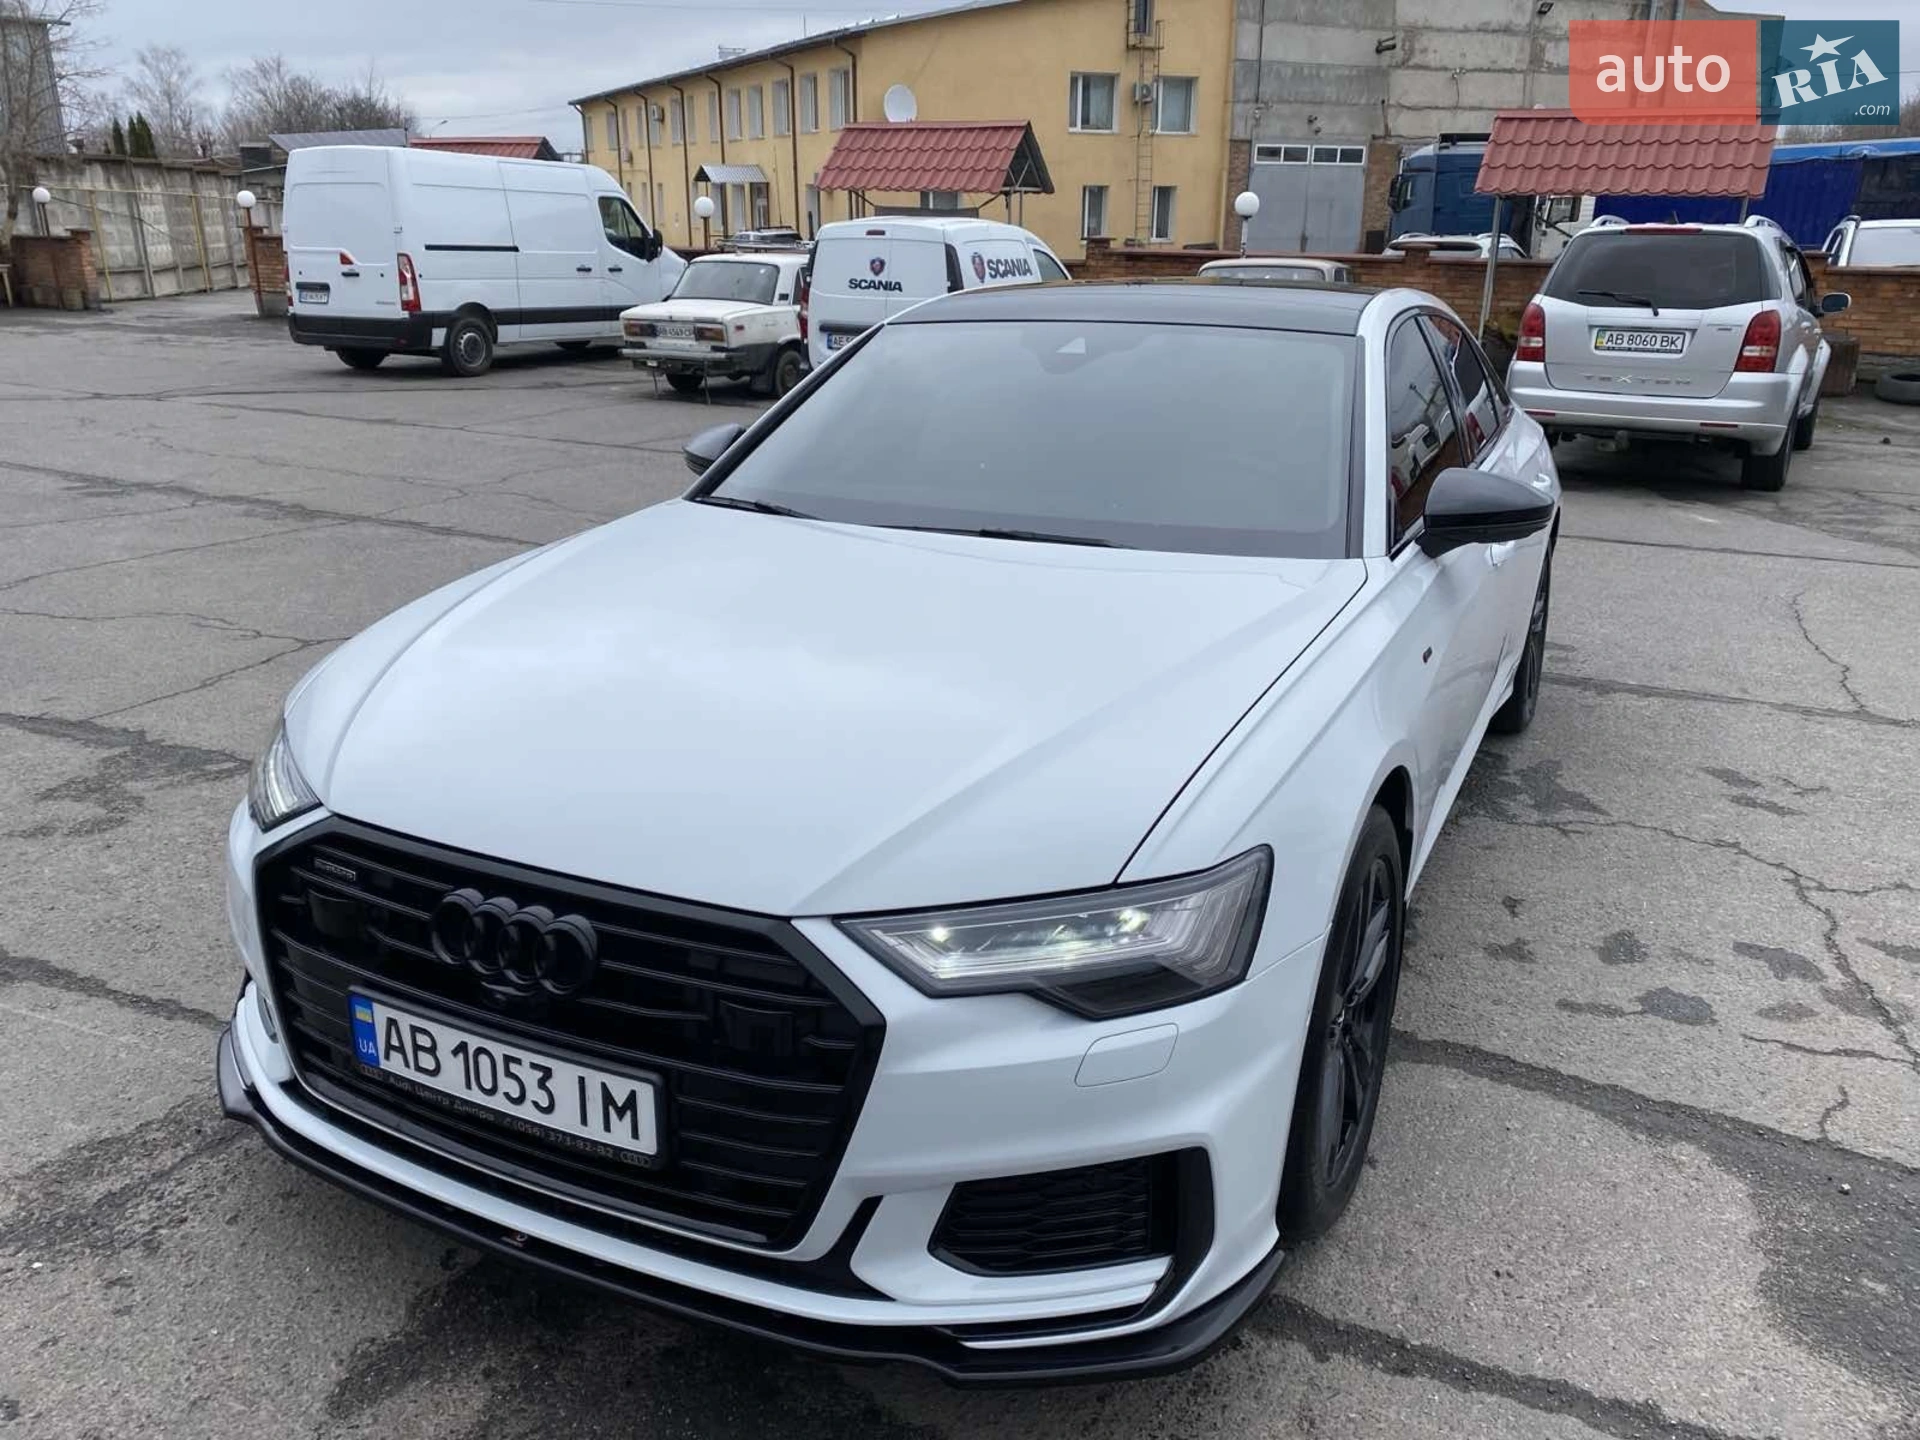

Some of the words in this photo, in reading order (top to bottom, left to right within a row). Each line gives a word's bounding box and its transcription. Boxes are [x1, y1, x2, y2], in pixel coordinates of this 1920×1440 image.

[987, 258, 1034, 279] SCANIA
[848, 278, 903, 293] SCANIA
[1605, 333, 1625, 346] AB
[1627, 334, 1658, 347] 8060
[1660, 335, 1680, 348] BK
[358, 1037, 377, 1057] UA
[384, 1016, 441, 1077] AB
[451, 1040, 556, 1115] 1053
[578, 1075, 640, 1141] IM
